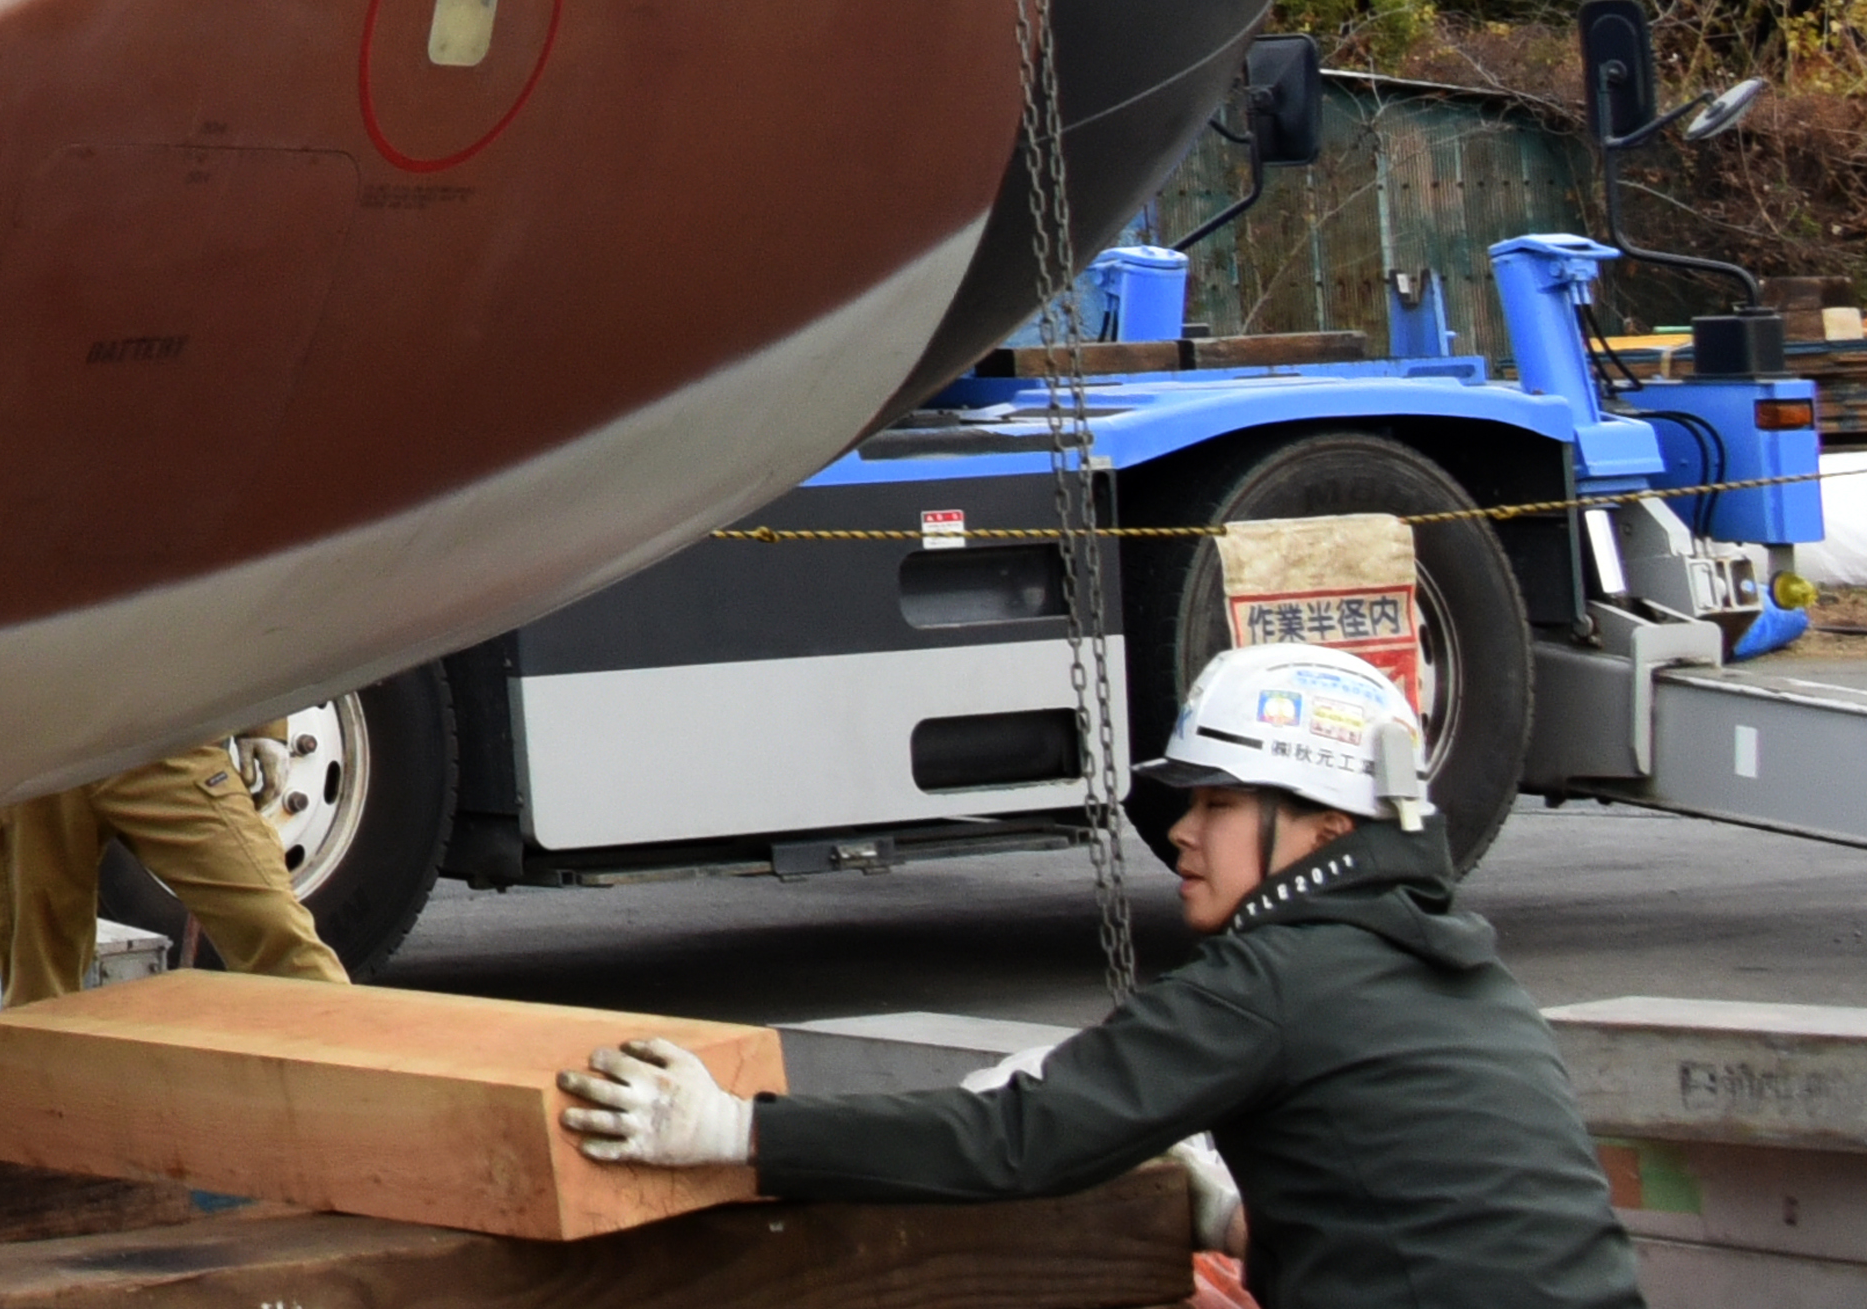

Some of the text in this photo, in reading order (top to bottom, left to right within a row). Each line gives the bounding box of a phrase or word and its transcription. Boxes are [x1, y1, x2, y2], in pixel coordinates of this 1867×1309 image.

[1246, 596, 1402, 643] 作業半径内
